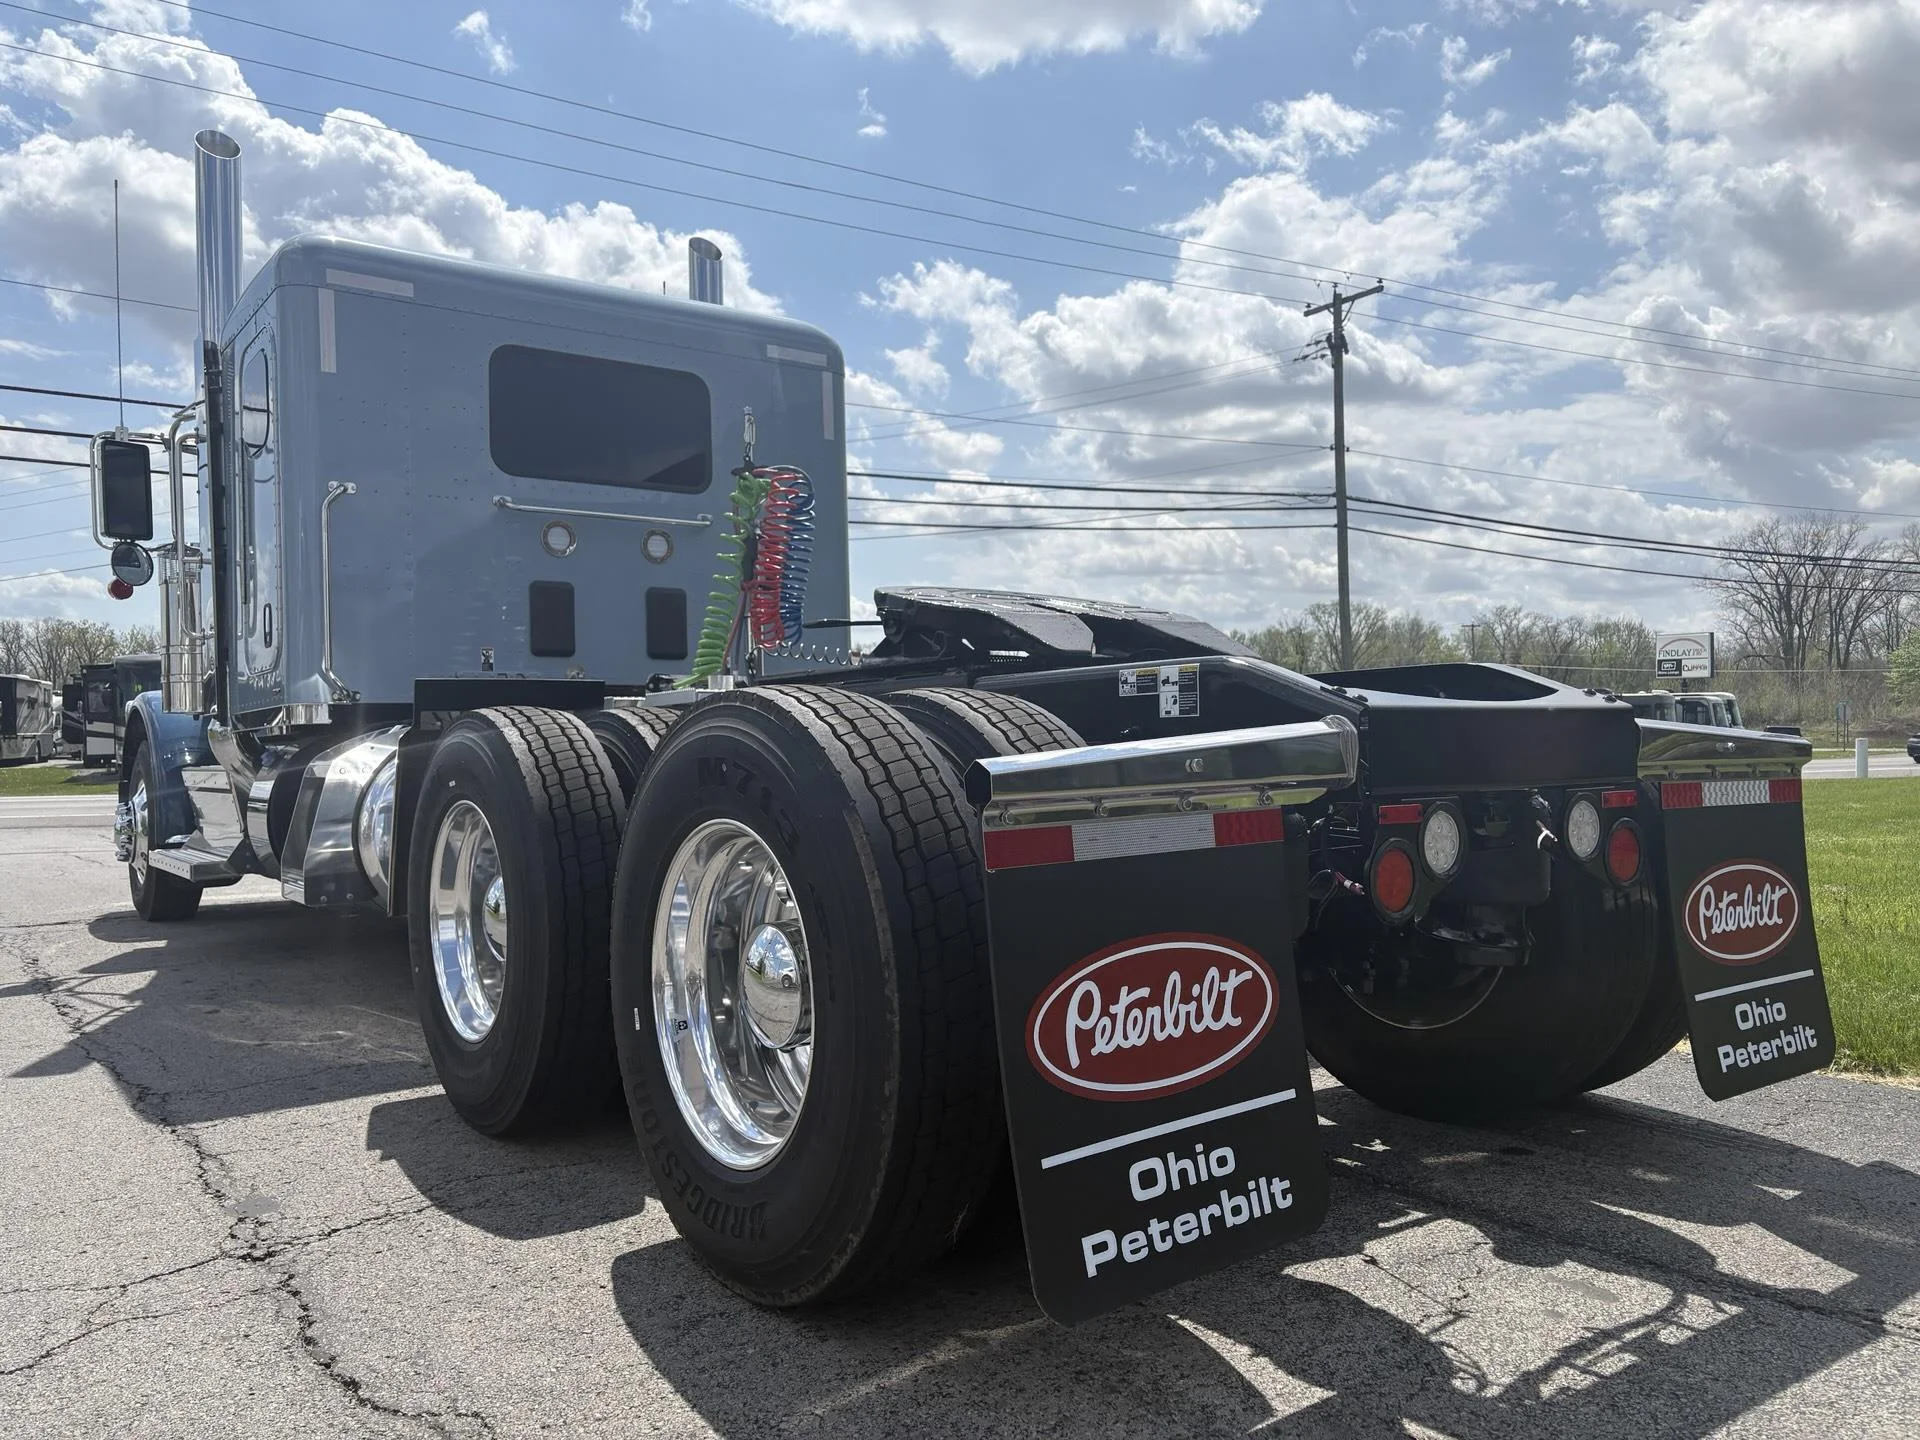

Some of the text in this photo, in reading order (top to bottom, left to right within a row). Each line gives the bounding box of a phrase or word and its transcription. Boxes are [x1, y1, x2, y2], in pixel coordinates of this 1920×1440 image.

[1658, 648, 1692, 658] FINDLAY
[1698, 883, 1788, 942] Peterbilt
[1065, 966, 1253, 1069] Peterbilt
[1735, 997, 1787, 1031] Ohio
[1717, 1024, 1818, 1073] Peterbilt
[1128, 1144, 1236, 1202] Ohio
[1081, 1174, 1294, 1279] Peterbilt
